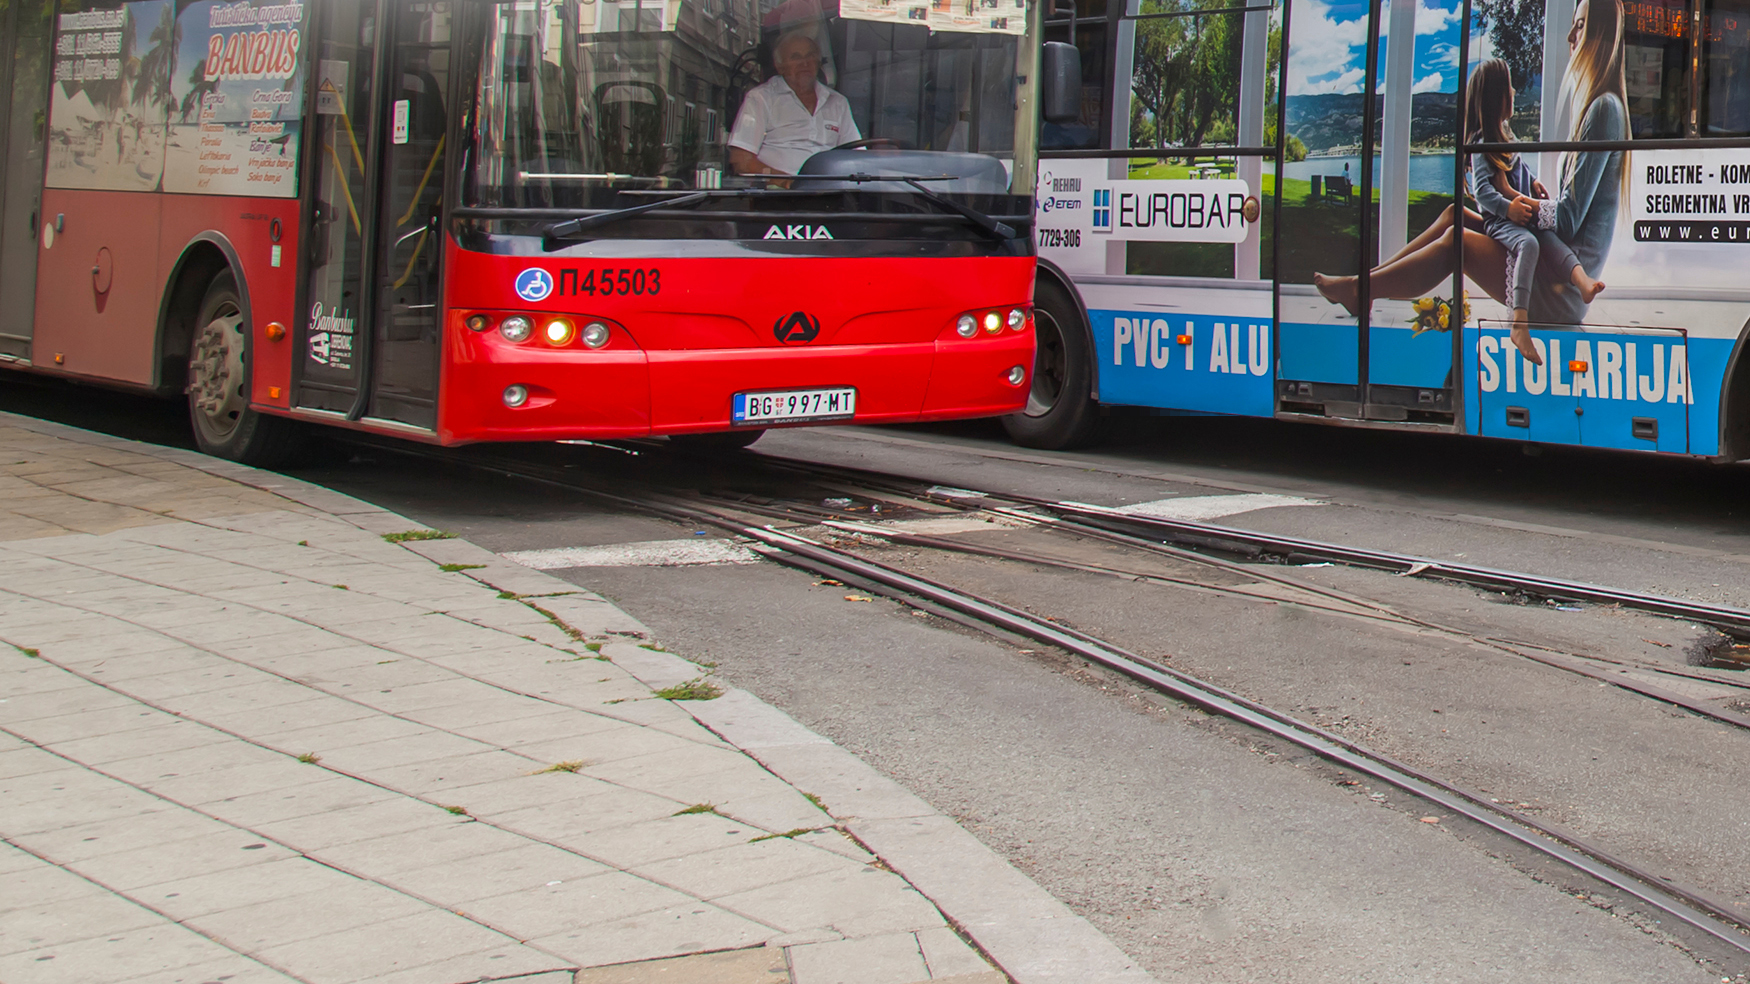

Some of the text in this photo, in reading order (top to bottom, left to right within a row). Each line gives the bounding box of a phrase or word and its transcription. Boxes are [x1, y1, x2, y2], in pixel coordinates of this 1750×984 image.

[206, 29, 300, 79] BANBUS
[252, 89, 292, 103] Crna Gora
[1052, 178, 1082, 192] REHAU
[1646, 164, 1703, 185] ROLETNE
[1055, 199, 1082, 209] ETEM
[1119, 192, 1246, 229] EUROBAR
[1645, 193, 1727, 214] SEGMENTNA
[763, 224, 834, 240] AKIA
[1039, 228, 1081, 248] 7729-306
[1113, 317, 1170, 369] PVC
[1209, 322, 1269, 377] ALU
[1475, 334, 1695, 405] STOLARIJA
